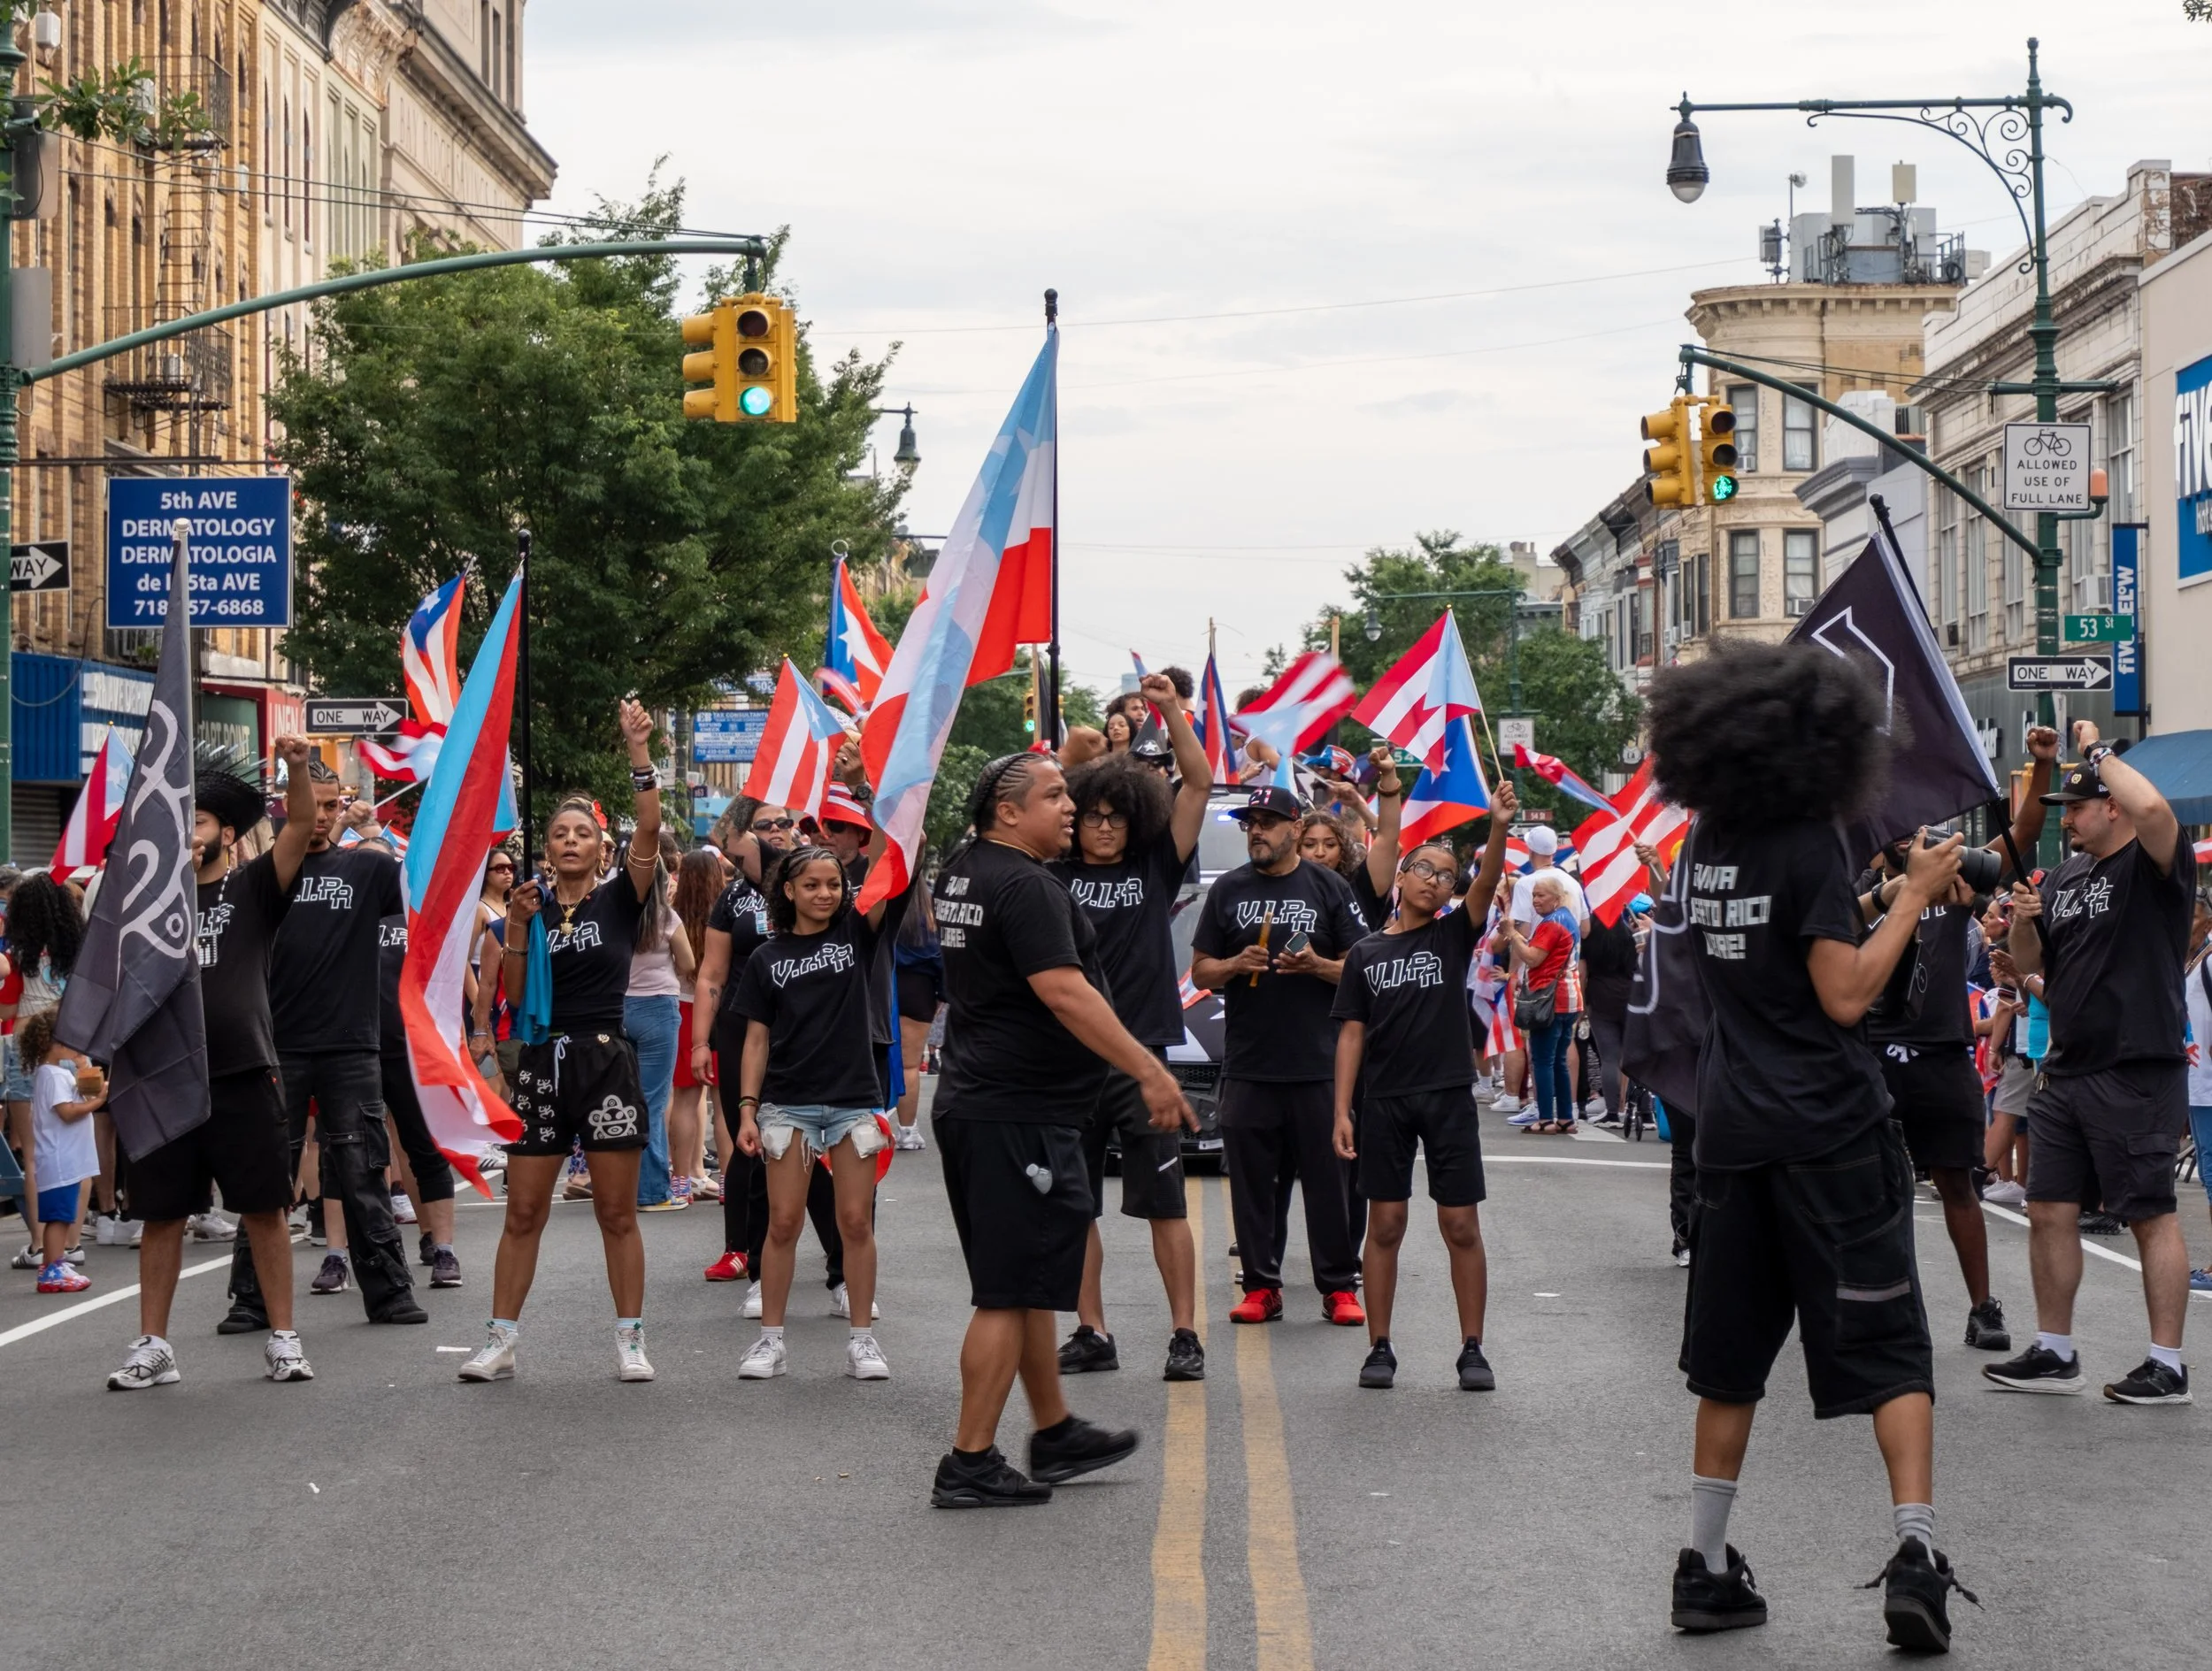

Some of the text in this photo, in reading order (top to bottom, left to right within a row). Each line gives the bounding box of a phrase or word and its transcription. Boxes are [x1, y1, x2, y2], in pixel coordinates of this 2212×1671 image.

[2016, 459, 2078, 471] ALLOWED
[2024, 476, 2070, 487] USE OF
[160, 491, 237, 510] 5th AVE
[2011, 493, 2083, 504] FULL LANE
[121, 518, 276, 537] DERMTOLOGY
[120, 545, 277, 564] DERMTOLOGIA
[137, 573, 161, 592] de
[188, 574, 218, 591] 5ta
[222, 573, 261, 591] AVE
[2079, 617, 2114, 638] 53 St
[2017, 666, 2098, 679] ONE WAY
[317, 710, 343, 724] ONE
[362, 710, 389, 724] WAY
[1394, 751, 1415, 763] 54
[1250, 787, 1272, 806] 21
